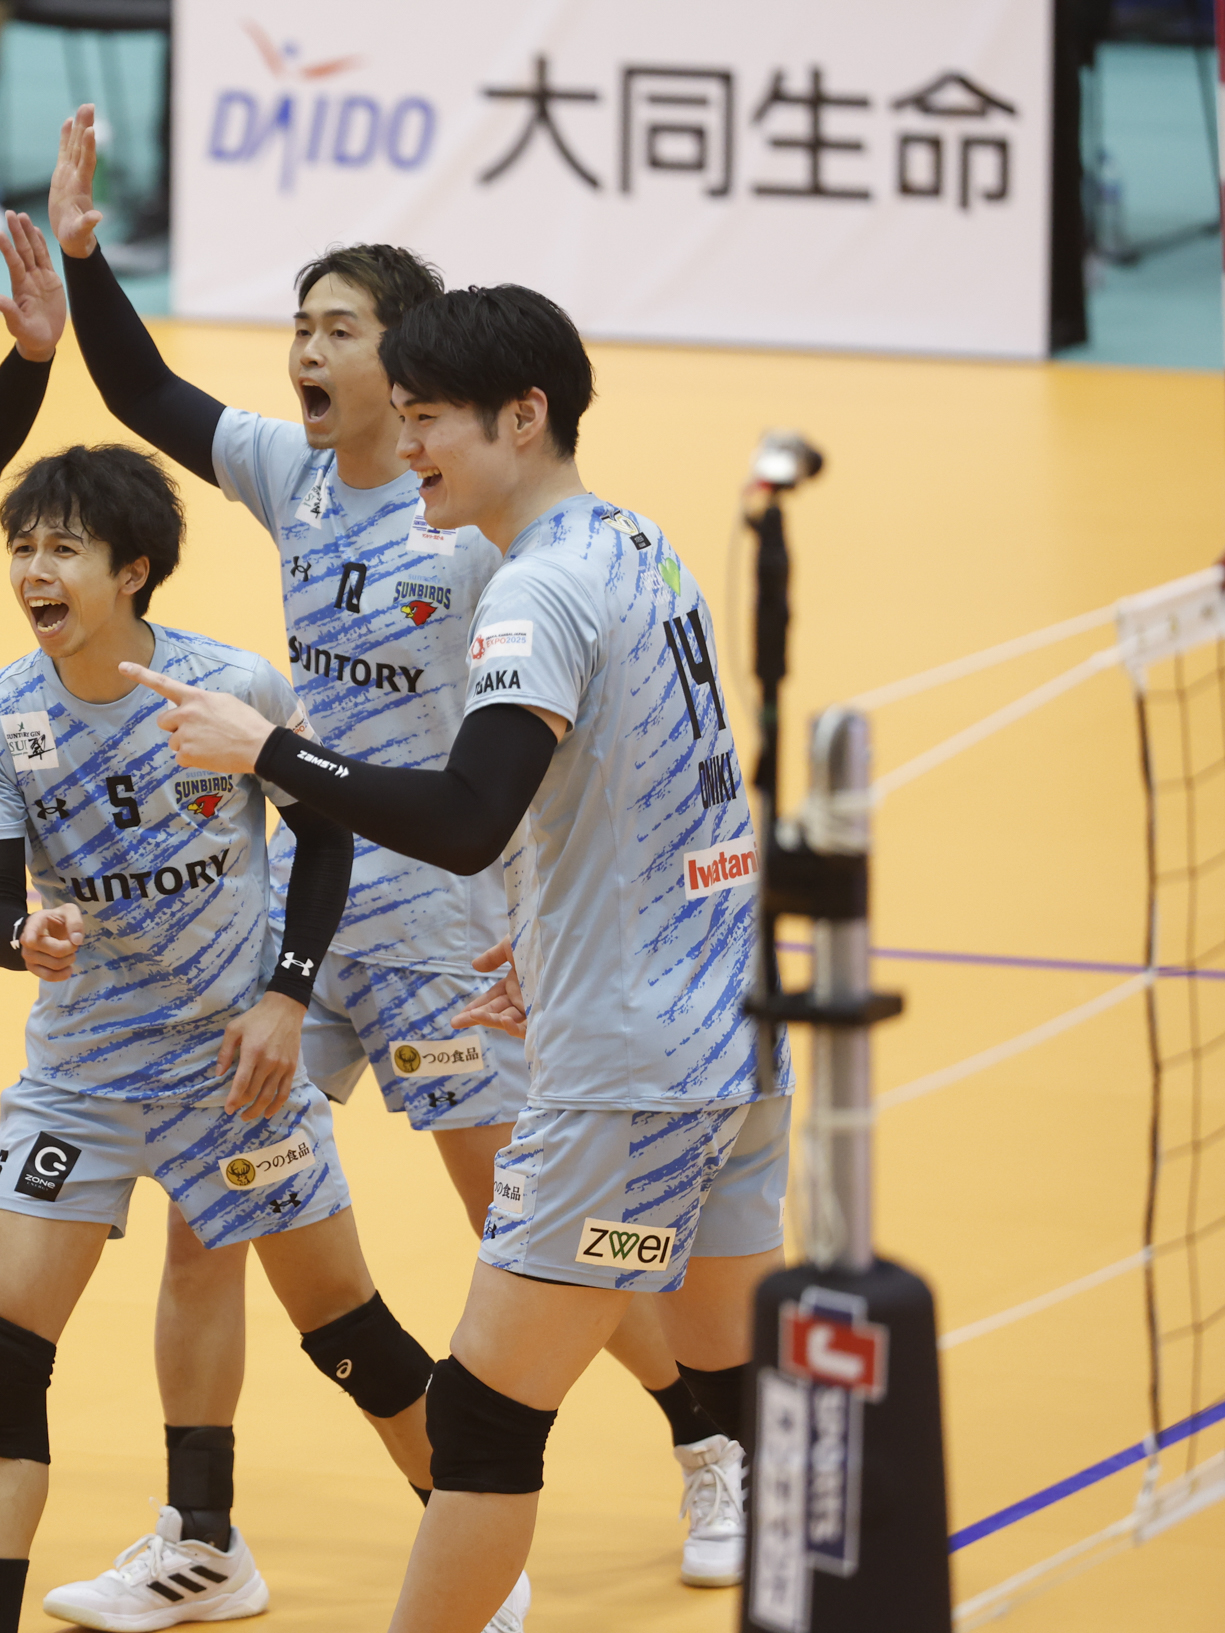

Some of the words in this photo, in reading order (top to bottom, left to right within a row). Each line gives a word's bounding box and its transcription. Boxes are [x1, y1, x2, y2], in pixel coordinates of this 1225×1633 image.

[210, 90, 438, 192] DAIDO
[479, 56, 1018, 208] 大同生命
[393, 580, 452, 611] SUNBIRDS
[288, 635, 424, 693] SUNTORY
[662, 609, 727, 741] 14
[106, 774, 142, 830] 5
[175, 774, 234, 805] SUNBIRDS
[698, 752, 736, 810] ONIKI
[59, 848, 230, 903] UNTORY
[422, 1048, 479, 1065] つの食品
[256, 1142, 310, 1172] つの食品
